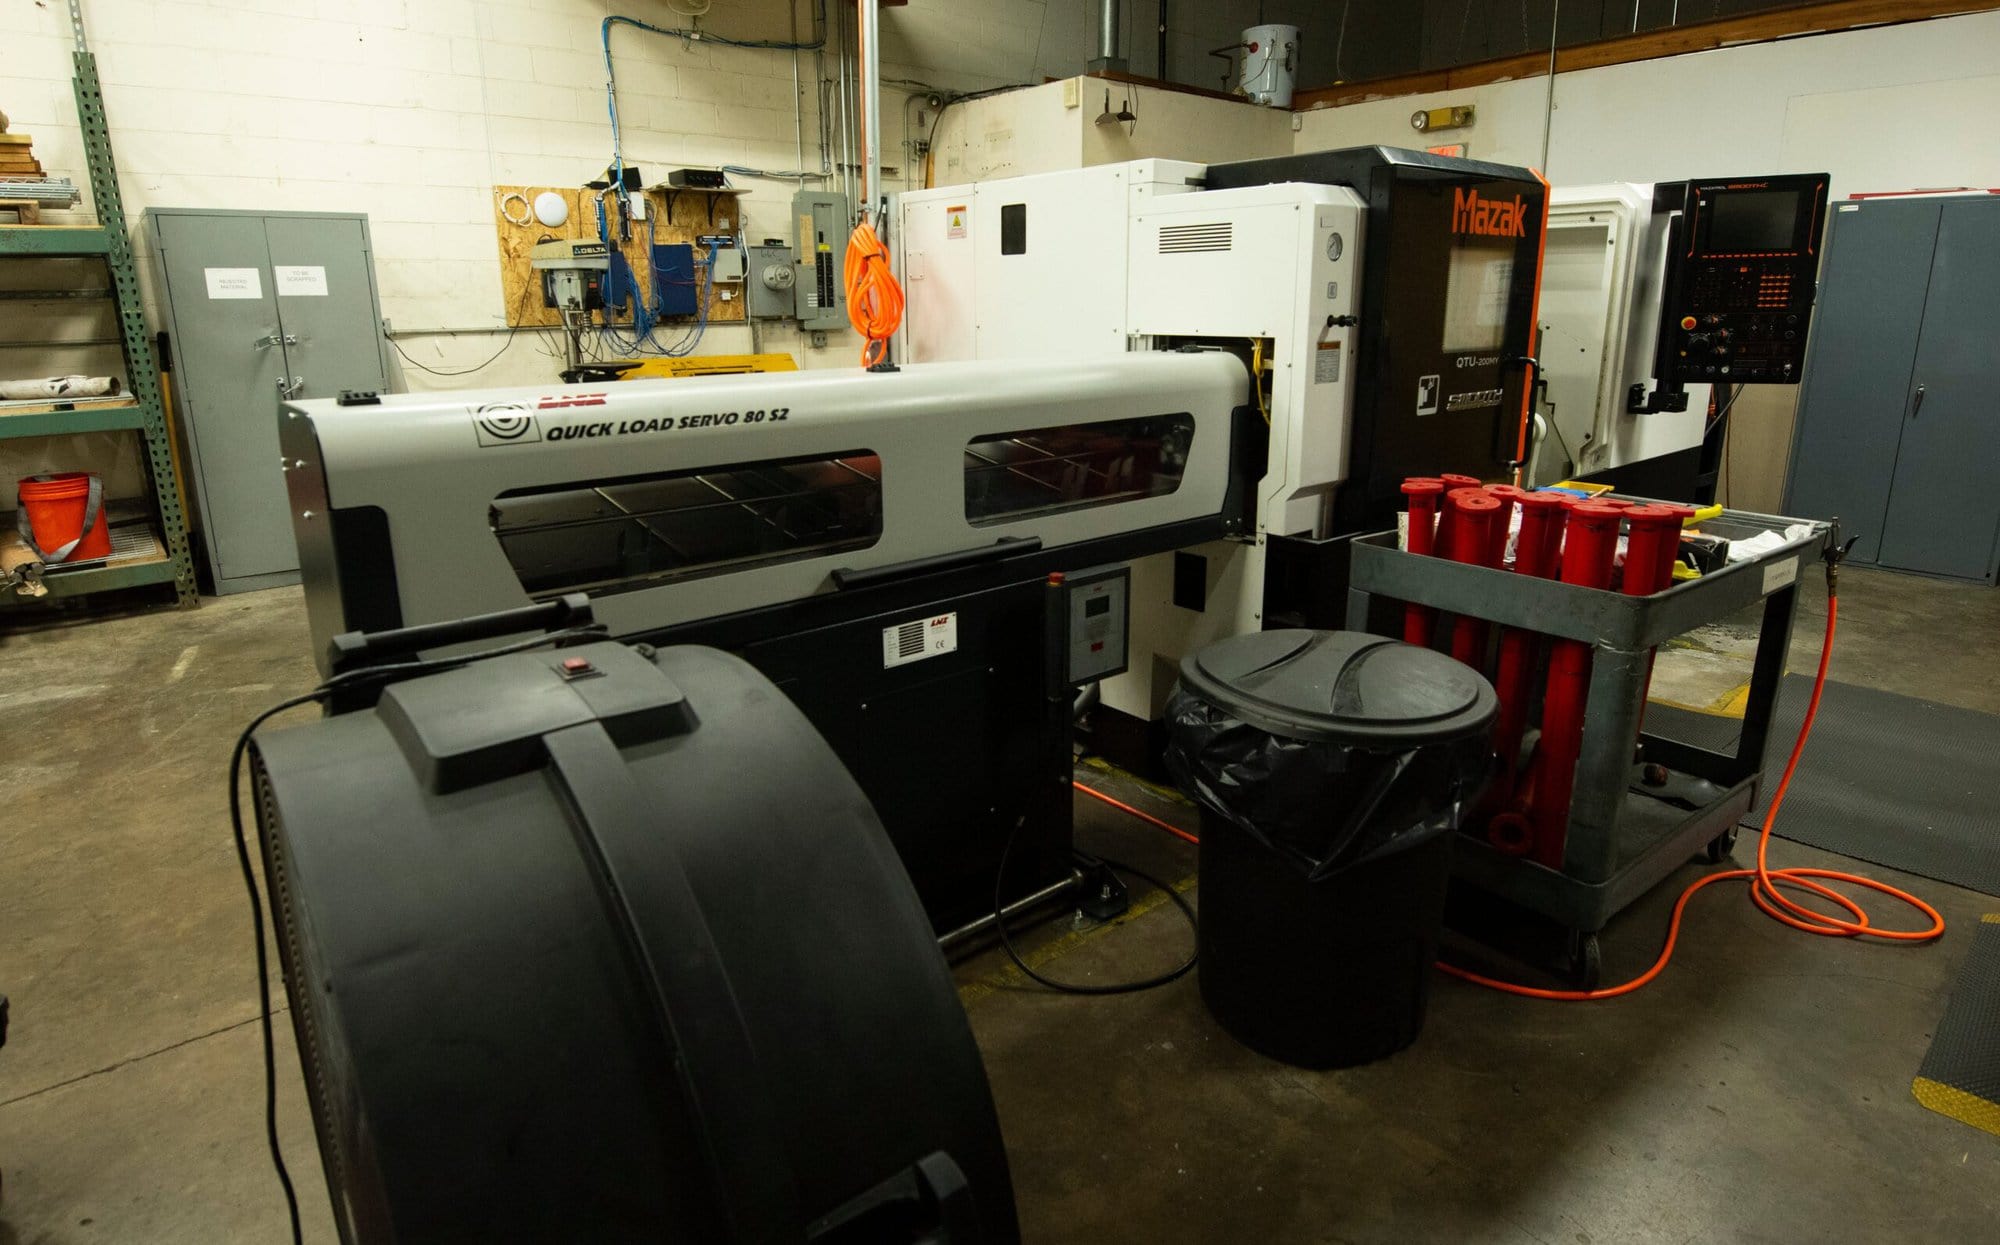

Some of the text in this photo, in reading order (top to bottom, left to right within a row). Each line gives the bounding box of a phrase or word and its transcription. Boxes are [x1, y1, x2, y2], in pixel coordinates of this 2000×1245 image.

[1452, 187, 1527, 237] Mazak
[546, 420, 613, 442] QUICK
[618, 415, 674, 434] LOAD
[678, 411, 738, 429] SERVO
[743, 408, 765, 423] 80
